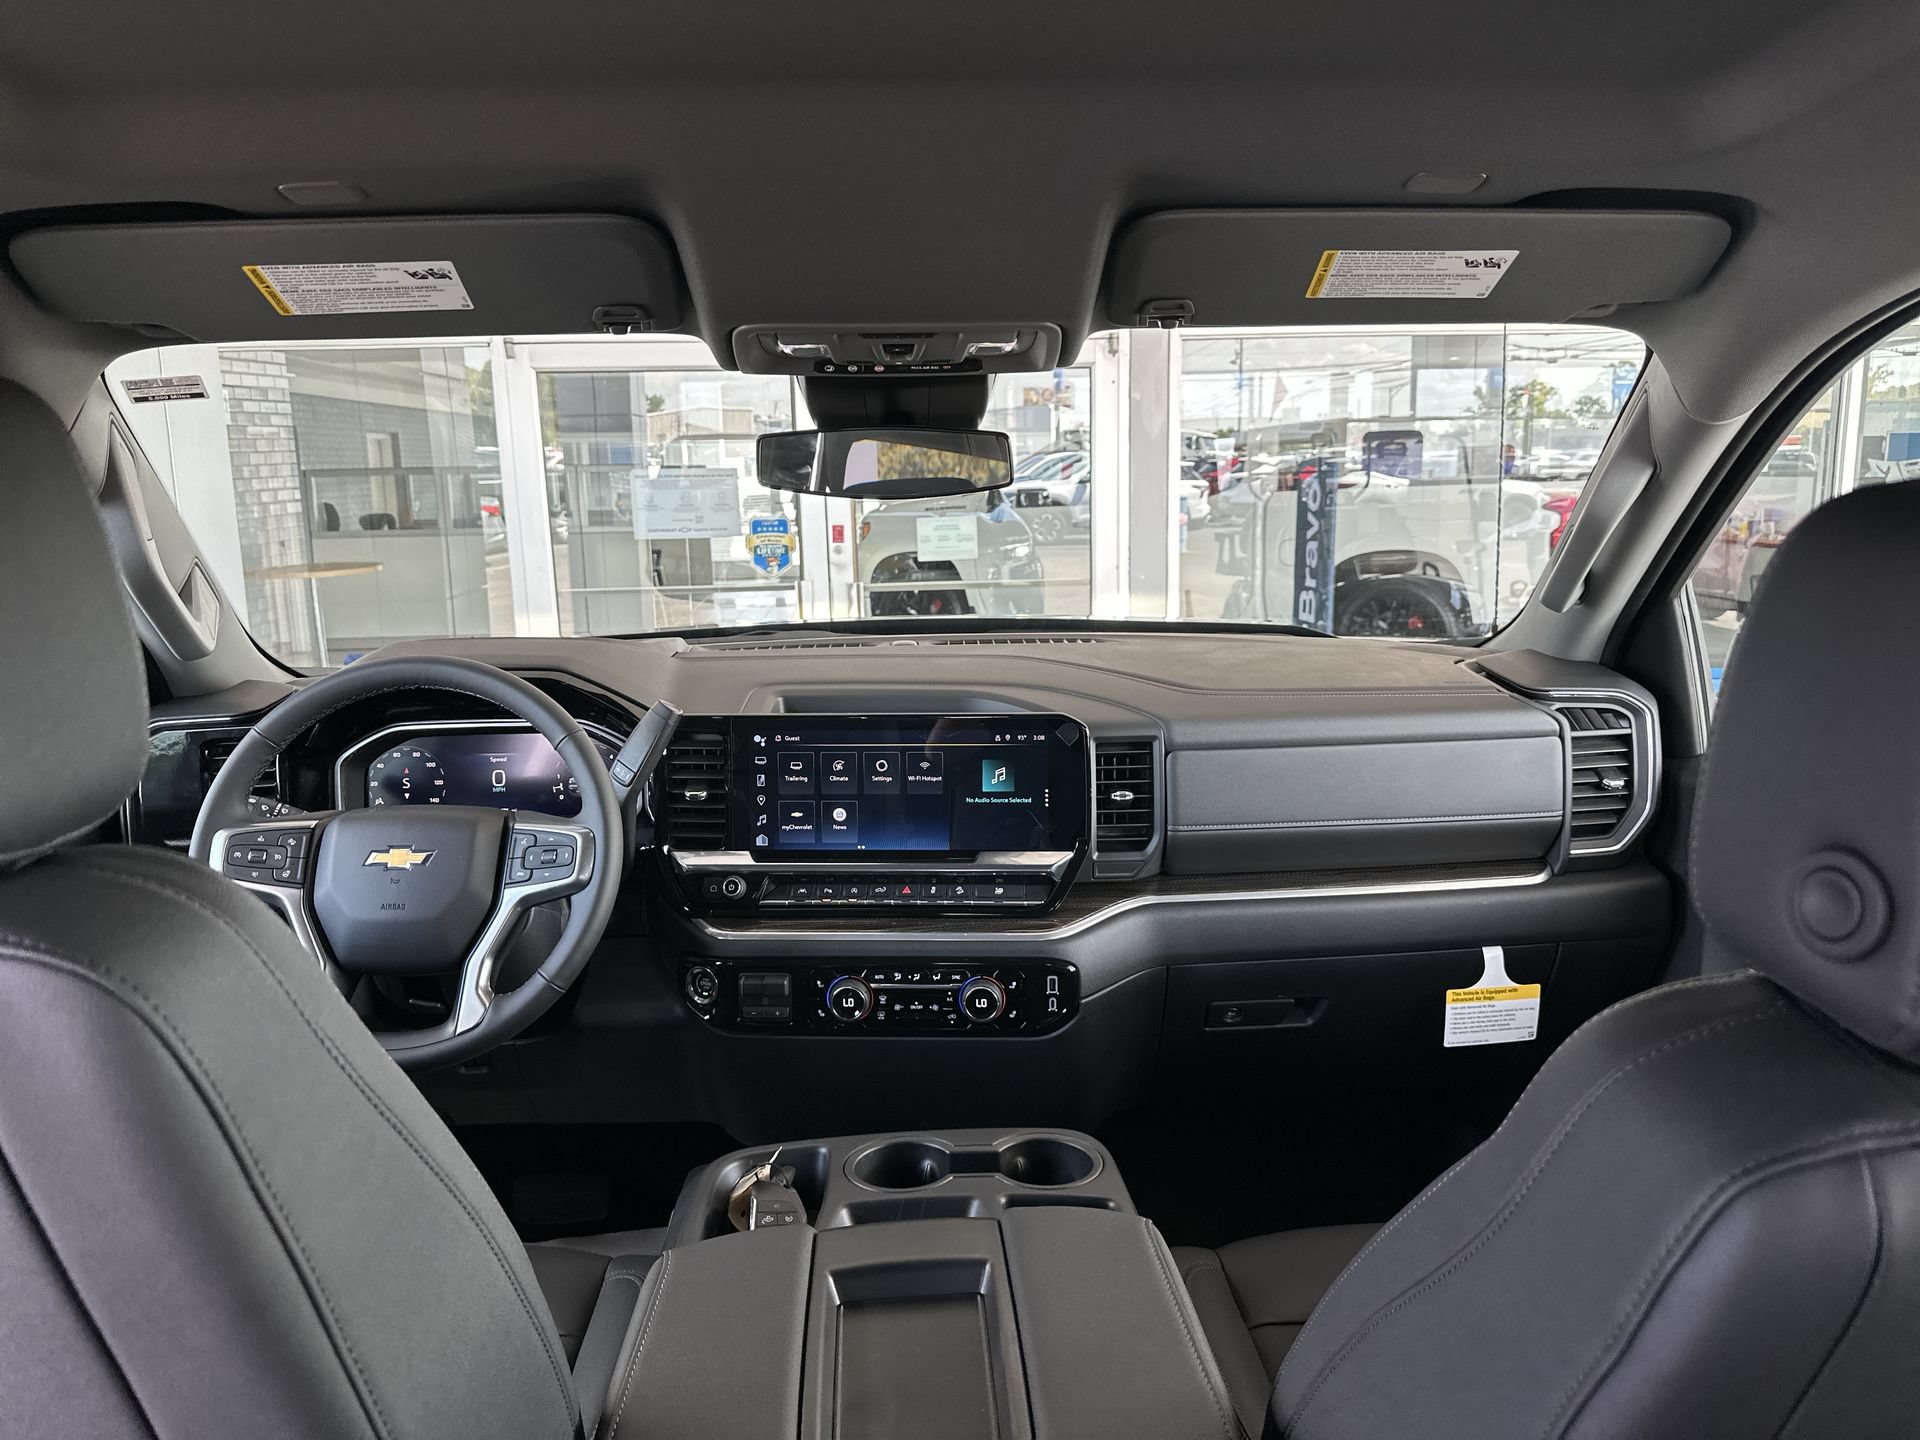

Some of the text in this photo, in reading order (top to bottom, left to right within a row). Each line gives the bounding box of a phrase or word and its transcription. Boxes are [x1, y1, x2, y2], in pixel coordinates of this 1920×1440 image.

[402, 777, 411, 789] S
[784, 775, 808, 783] Trailering
[871, 775, 893, 783] Settings
[922, 775, 942, 783] Hotspot
[380, 903, 406, 911] AIRBAG
